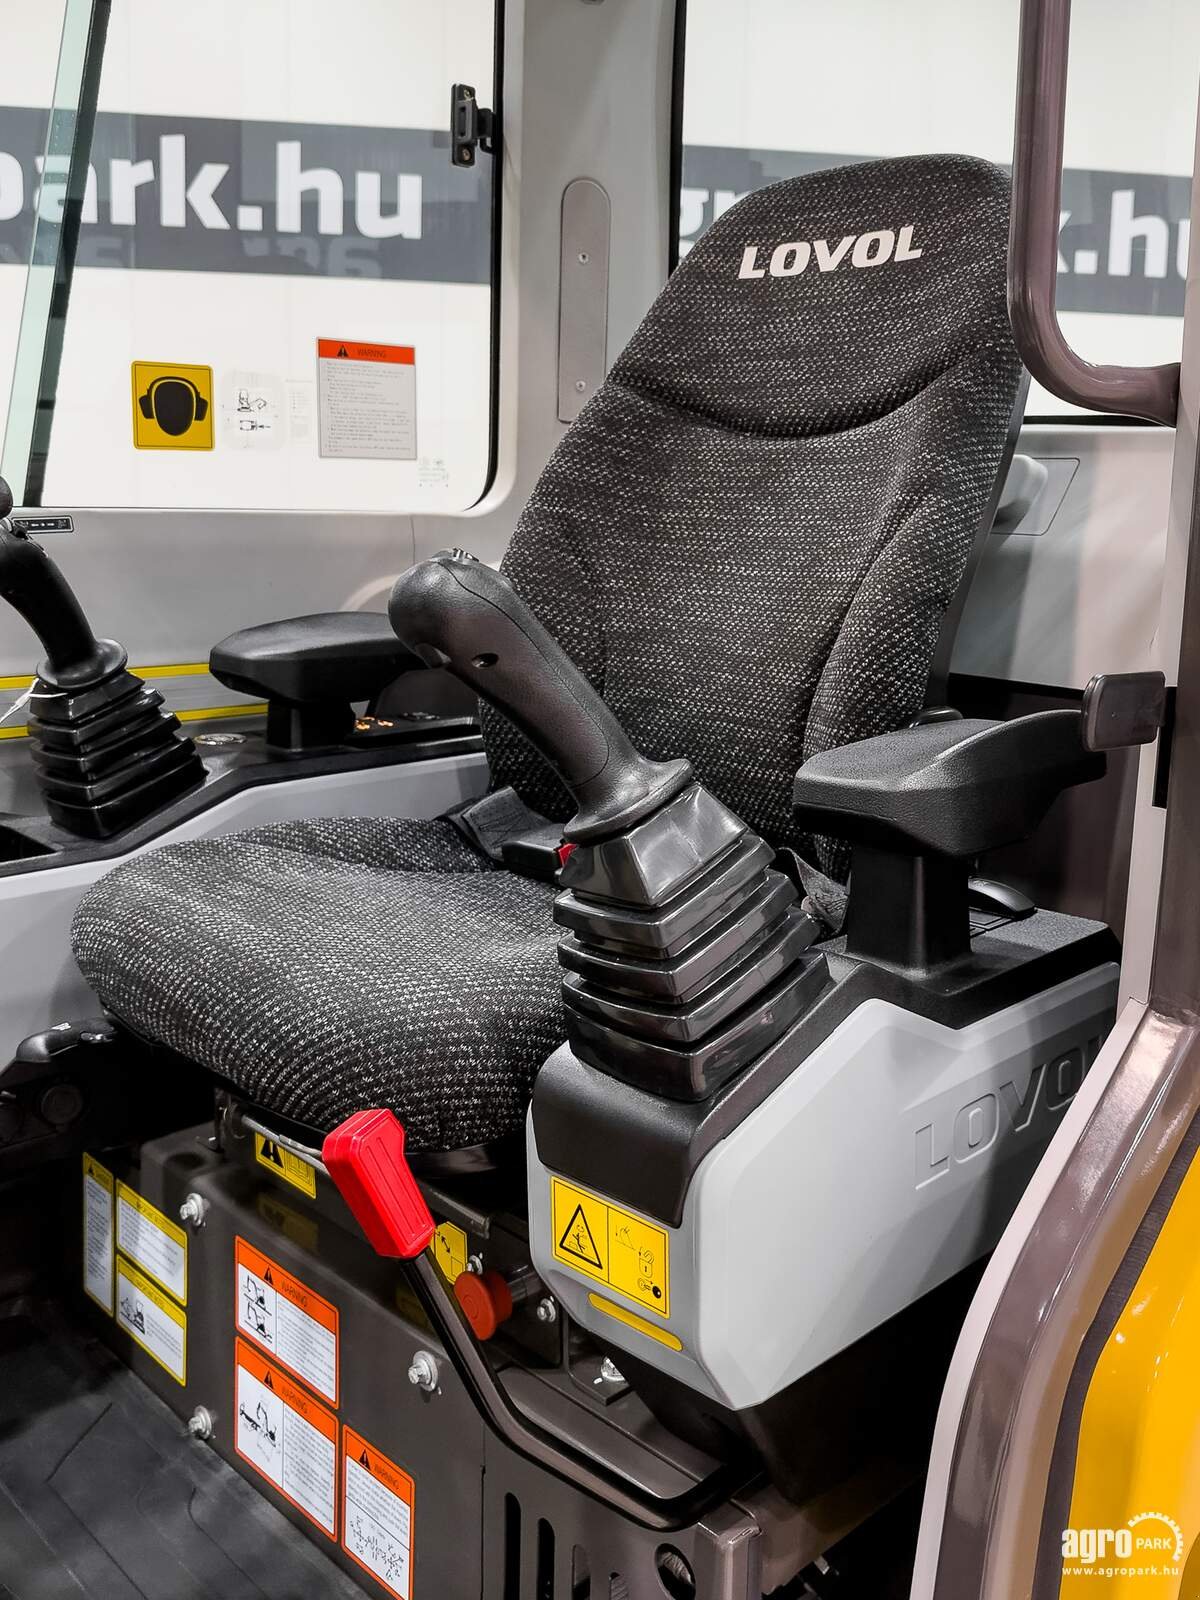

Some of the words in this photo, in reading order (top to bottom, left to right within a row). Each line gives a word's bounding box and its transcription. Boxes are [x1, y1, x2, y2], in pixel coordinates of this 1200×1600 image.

[738, 225, 923, 280] LOVOL
[914, 1034, 1101, 1190] LOVO
[281, 1281, 308, 1307] WARNING
[281, 1386, 308, 1414] WARNING
[374, 1463, 400, 1490] WARNING
